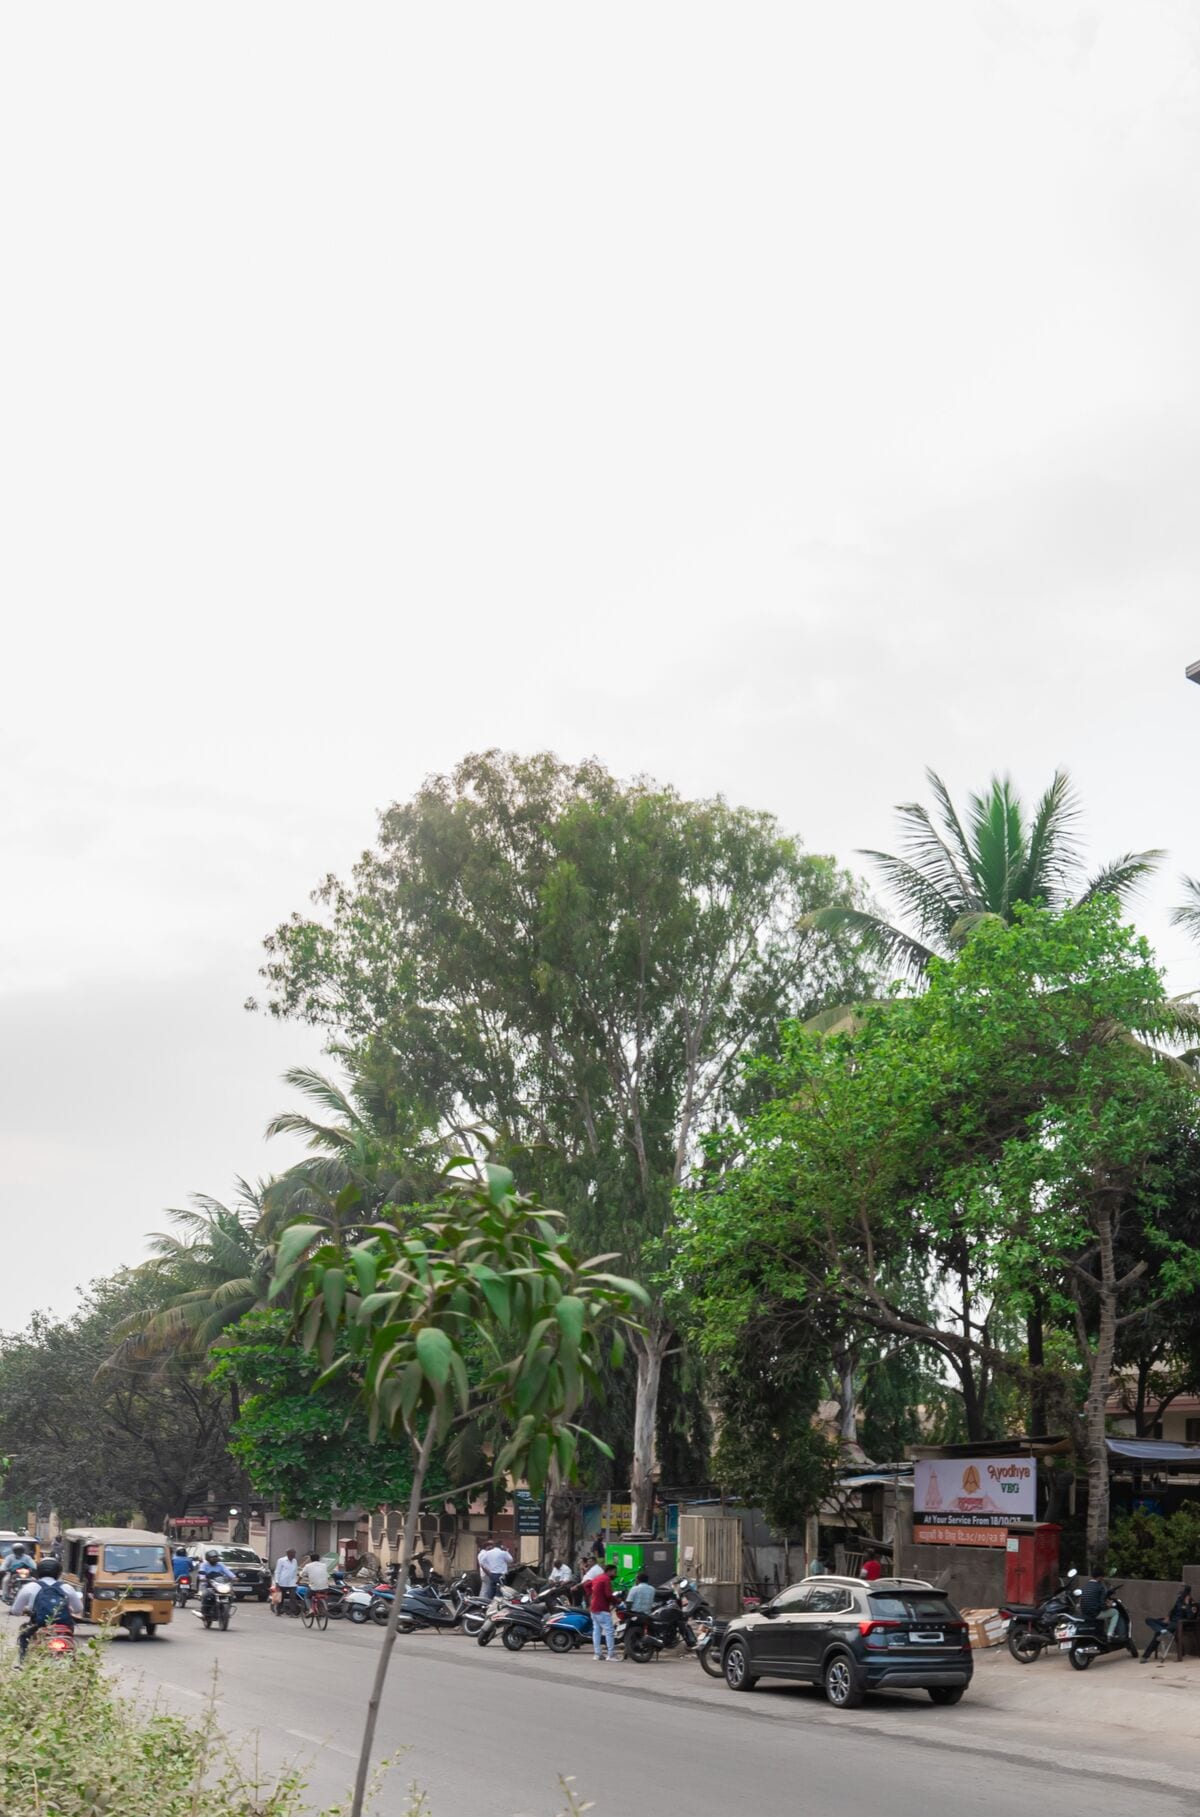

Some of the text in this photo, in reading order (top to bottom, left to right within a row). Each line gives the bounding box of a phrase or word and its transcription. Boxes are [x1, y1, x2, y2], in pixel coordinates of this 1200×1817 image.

[987, 1464, 1031, 1482] Ayodhya
[1001, 1482, 1020, 1493] VEG
[923, 1514, 932, 1524] At
[933, 1515, 948, 1524] Your
[948, 1515, 972, 1525] Service
[972, 1516, 990, 1525] From
